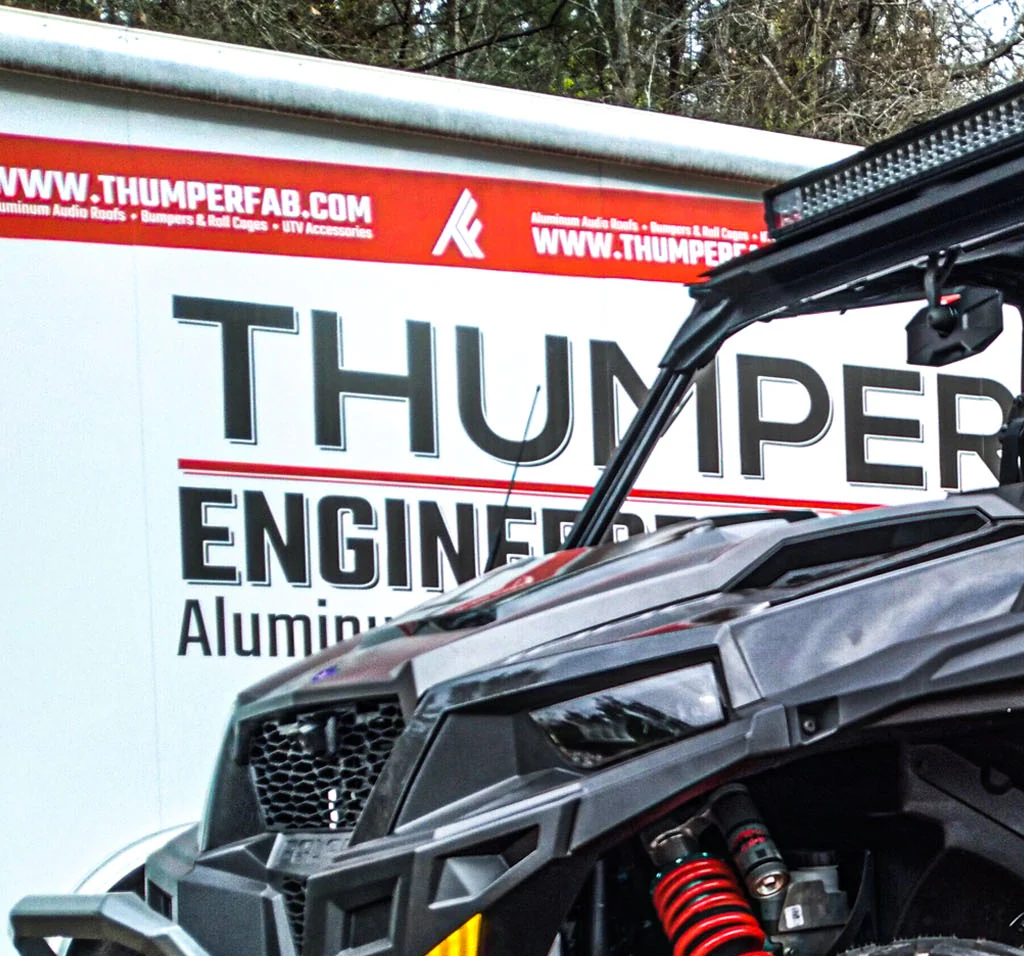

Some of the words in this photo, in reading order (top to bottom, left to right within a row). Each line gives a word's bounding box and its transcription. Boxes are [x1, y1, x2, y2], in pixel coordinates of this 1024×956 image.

[53, 203, 88, 219] Audio
[90, 206, 126, 221] Roofs
[141, 209, 193, 226] Bumpers
[196, 214, 206, 227] &
[208, 214, 230, 228] Roll
[232, 216, 268, 233] Cages
[282, 220, 304, 234] UTV
[306, 222, 373, 239] Accessories
[531, 211, 580, 227] Aluminum
[581, 216, 609, 229] Audio
[650, 221, 691, 236] Bumpers
[702, 225, 720, 238] Roll
[531, 226, 758, 267] WWW.THUMPERF
[178, 486, 698, 593] ENGINE
[177, 596, 393, 657] Alumin
